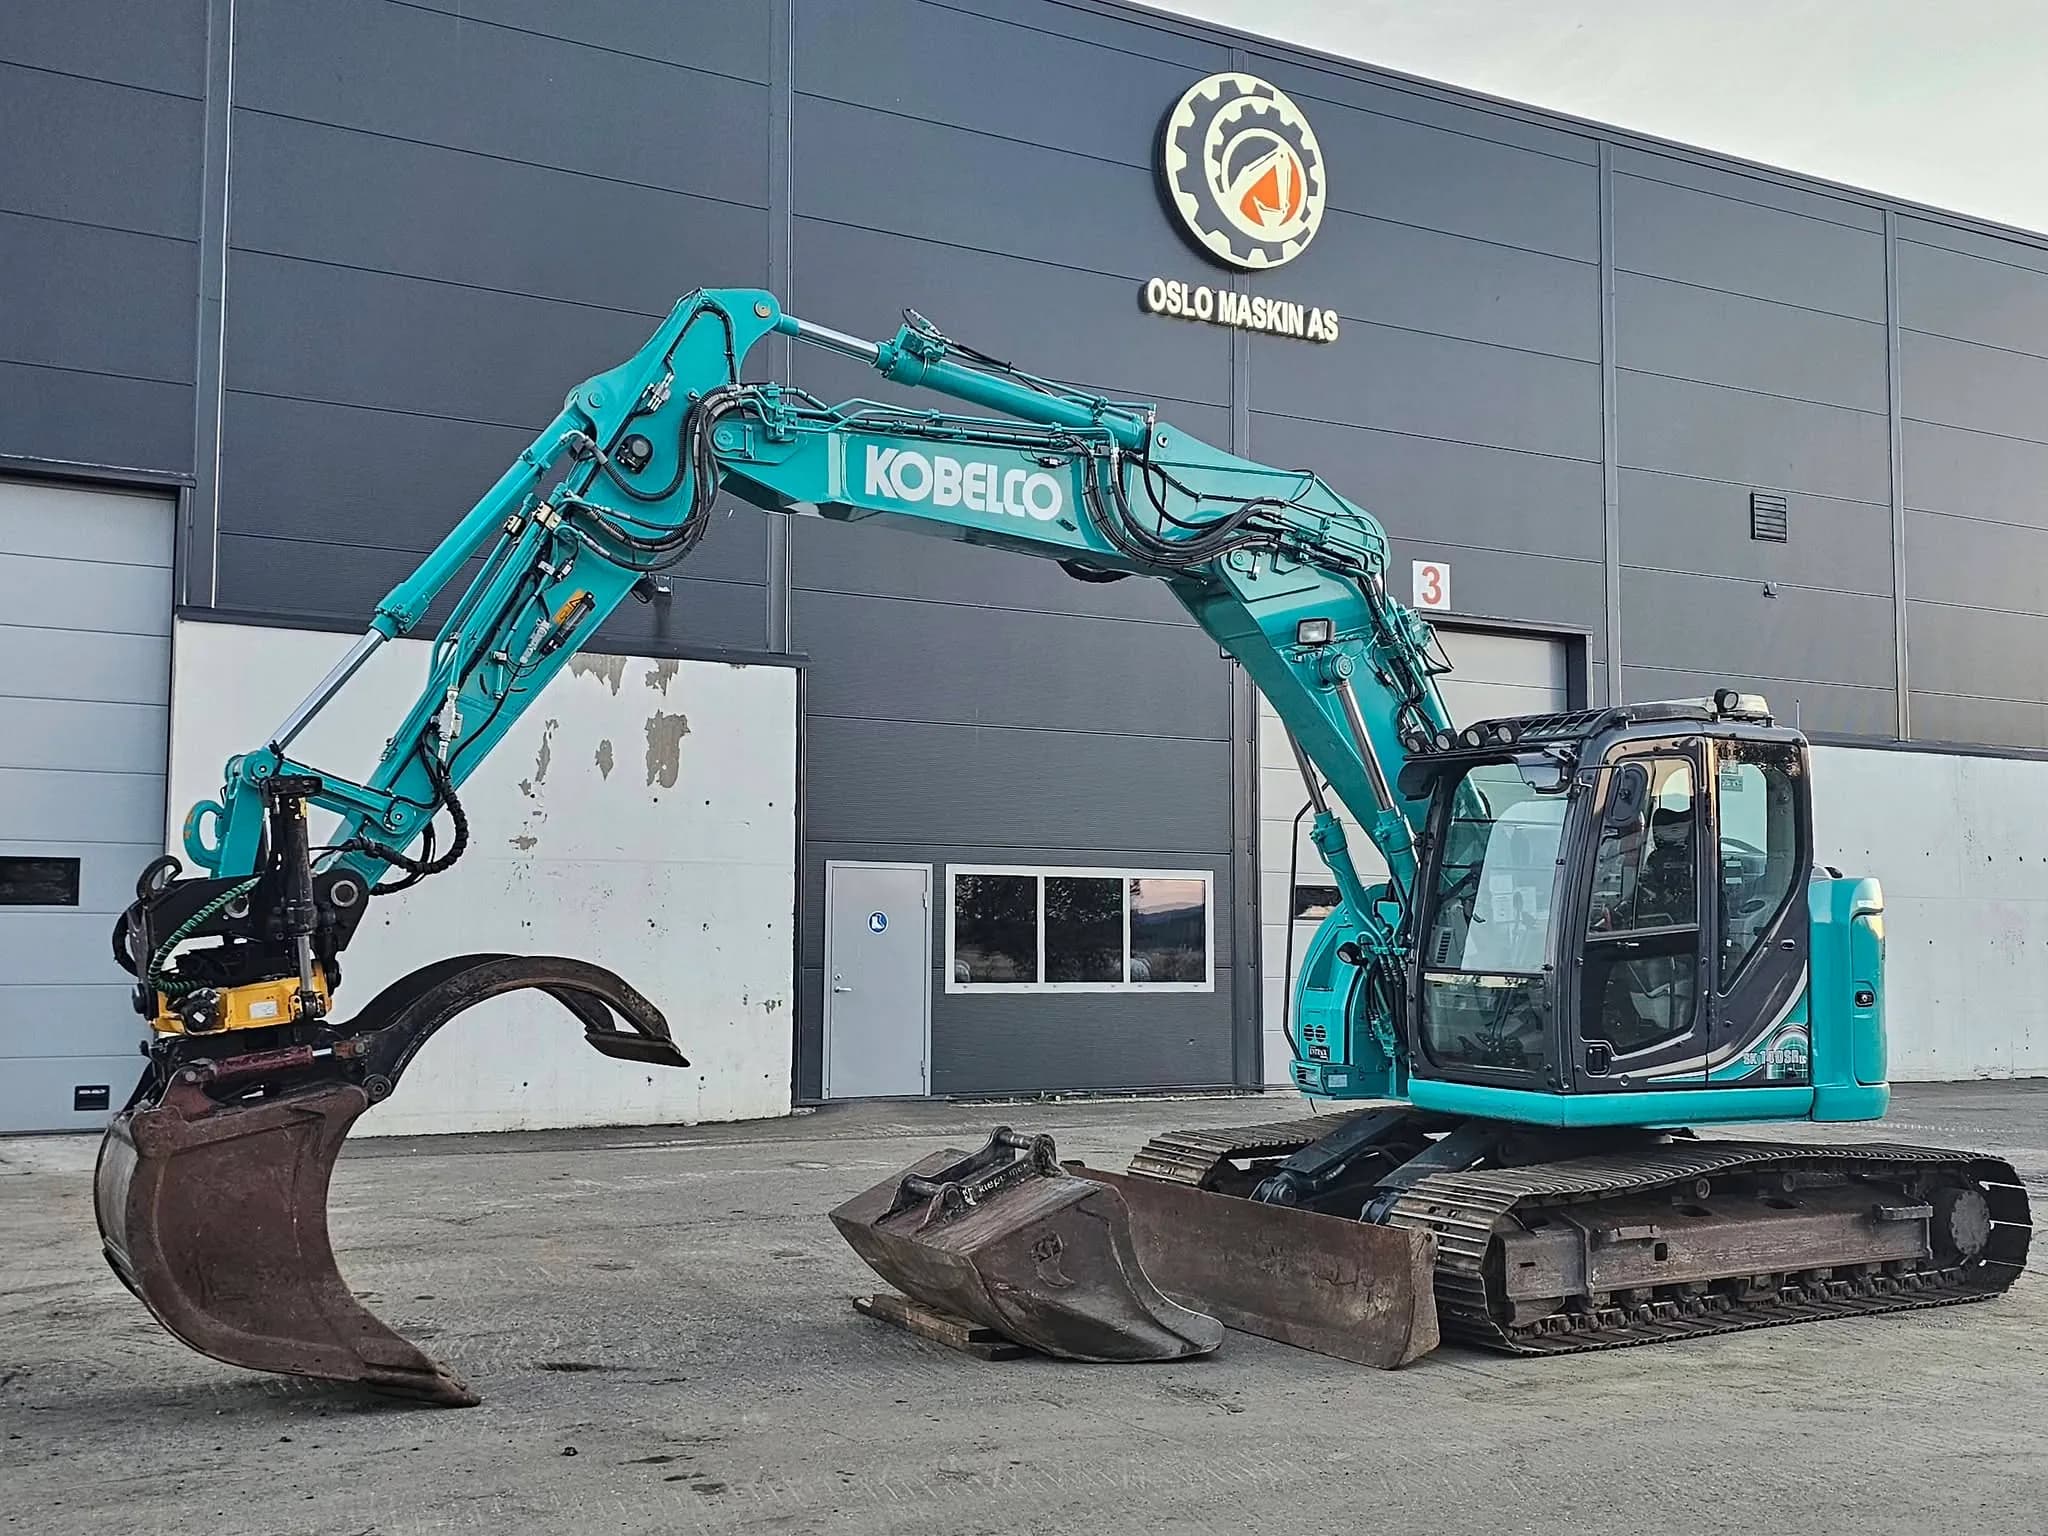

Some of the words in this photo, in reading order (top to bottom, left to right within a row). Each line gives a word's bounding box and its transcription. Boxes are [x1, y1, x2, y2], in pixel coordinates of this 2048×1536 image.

[1147, 278, 1213, 319] OSLO
[1218, 290, 1304, 337] MASKIN
[1307, 307, 1339, 341] AS
[865, 445, 1062, 520] KOBELCO
[1422, 566, 1442, 605] 3
